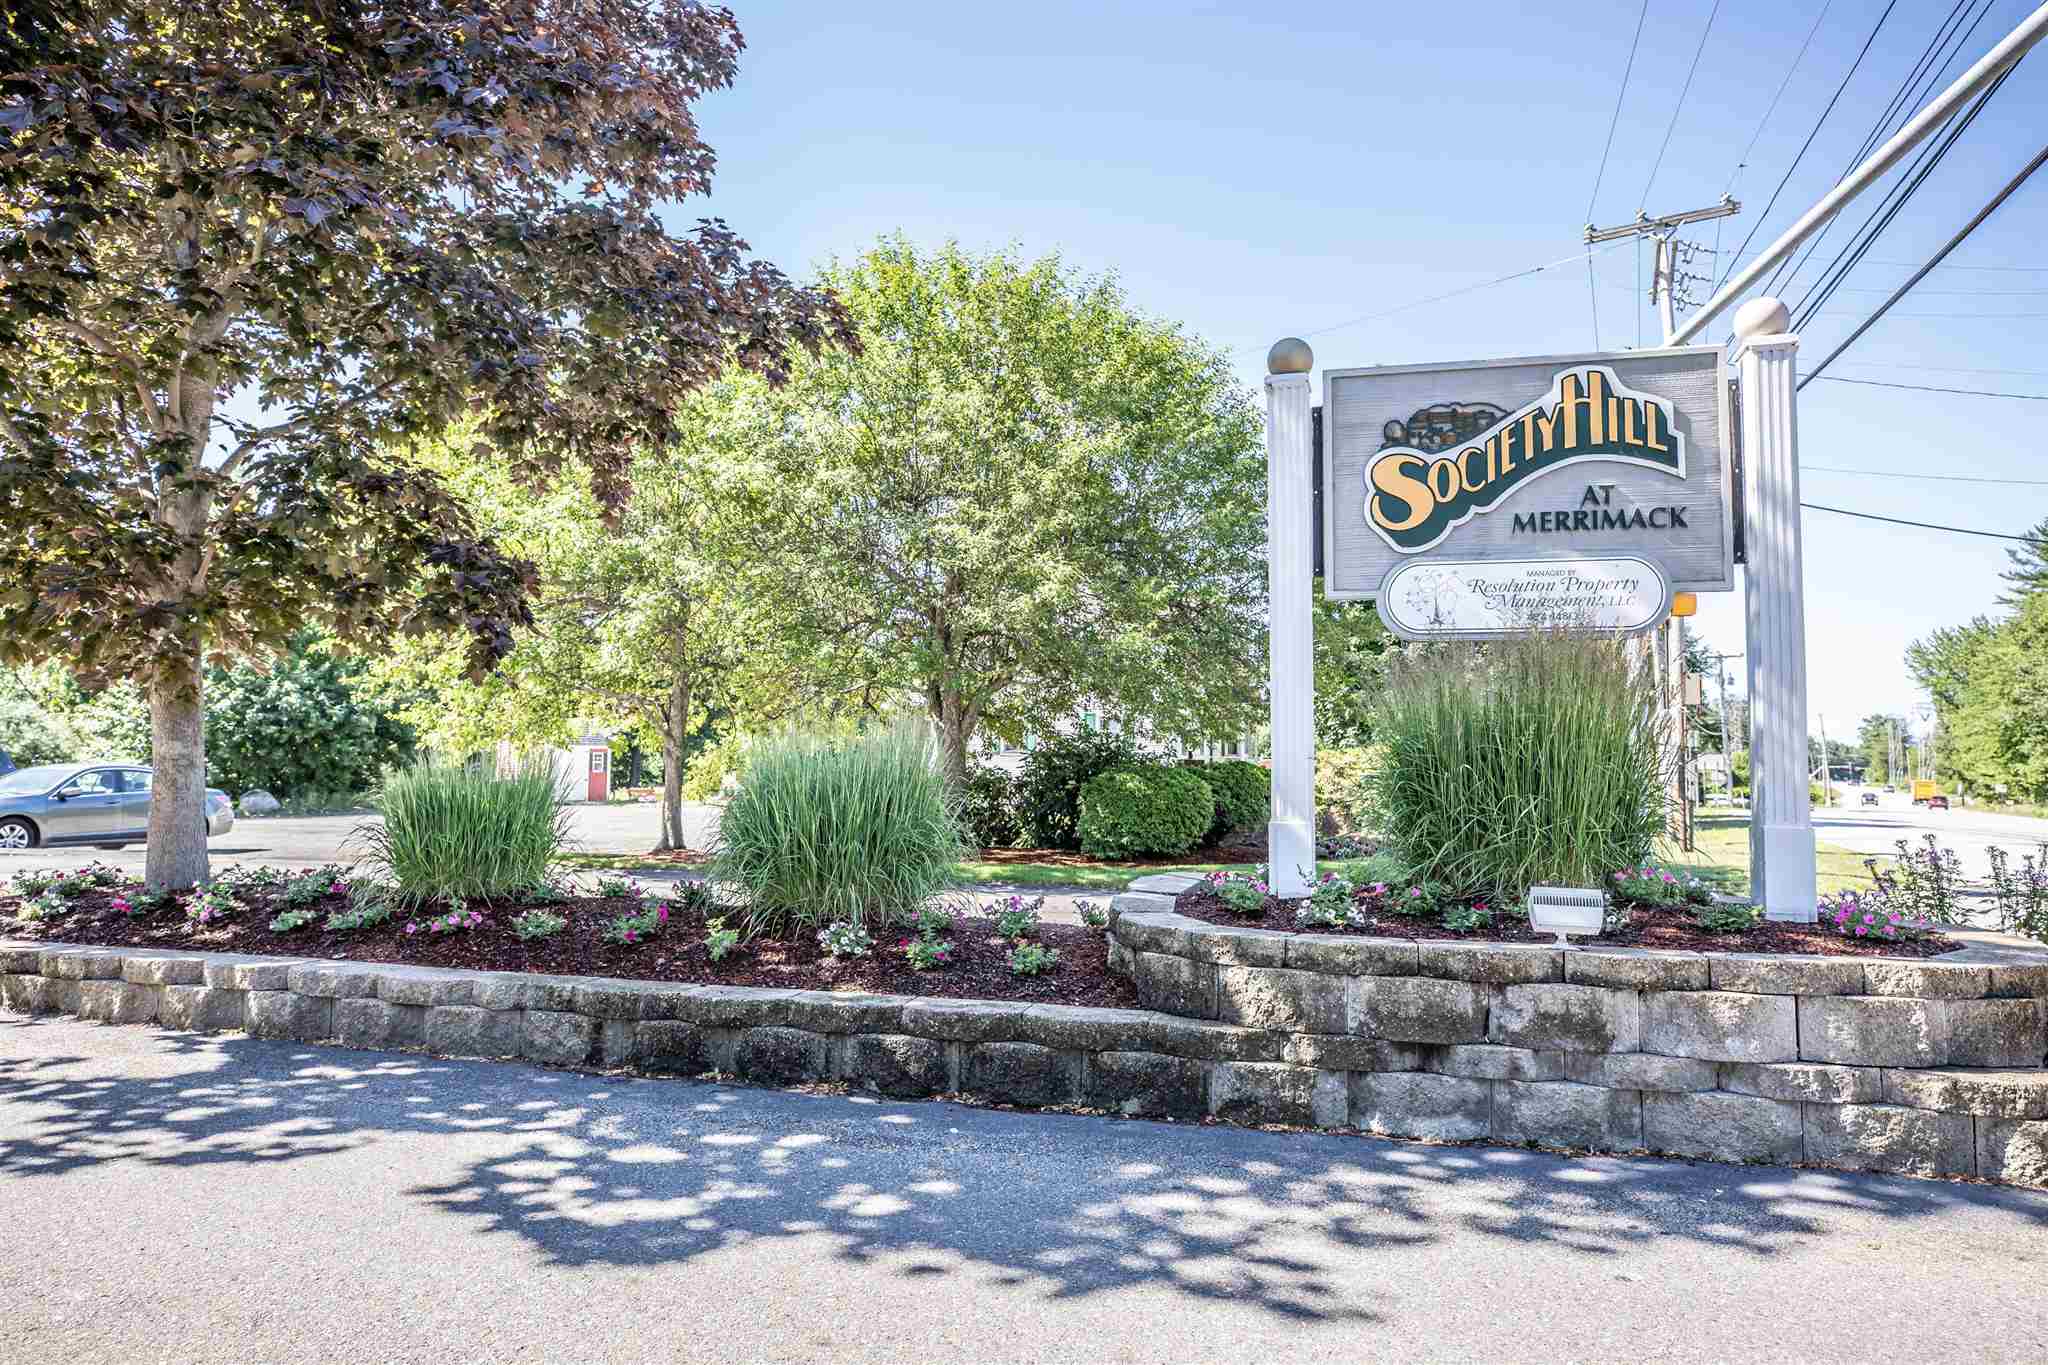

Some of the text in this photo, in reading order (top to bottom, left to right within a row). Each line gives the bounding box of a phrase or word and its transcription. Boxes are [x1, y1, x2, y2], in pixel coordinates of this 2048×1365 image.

[1371, 370, 1668, 531] SOCIETY HILL
[1580, 485, 1614, 508] AT
[1512, 506, 1688, 535] MERRIMACK
[1526, 569, 1577, 577] MANAGED BY
[1467, 575, 1639, 598] Resolution Property
